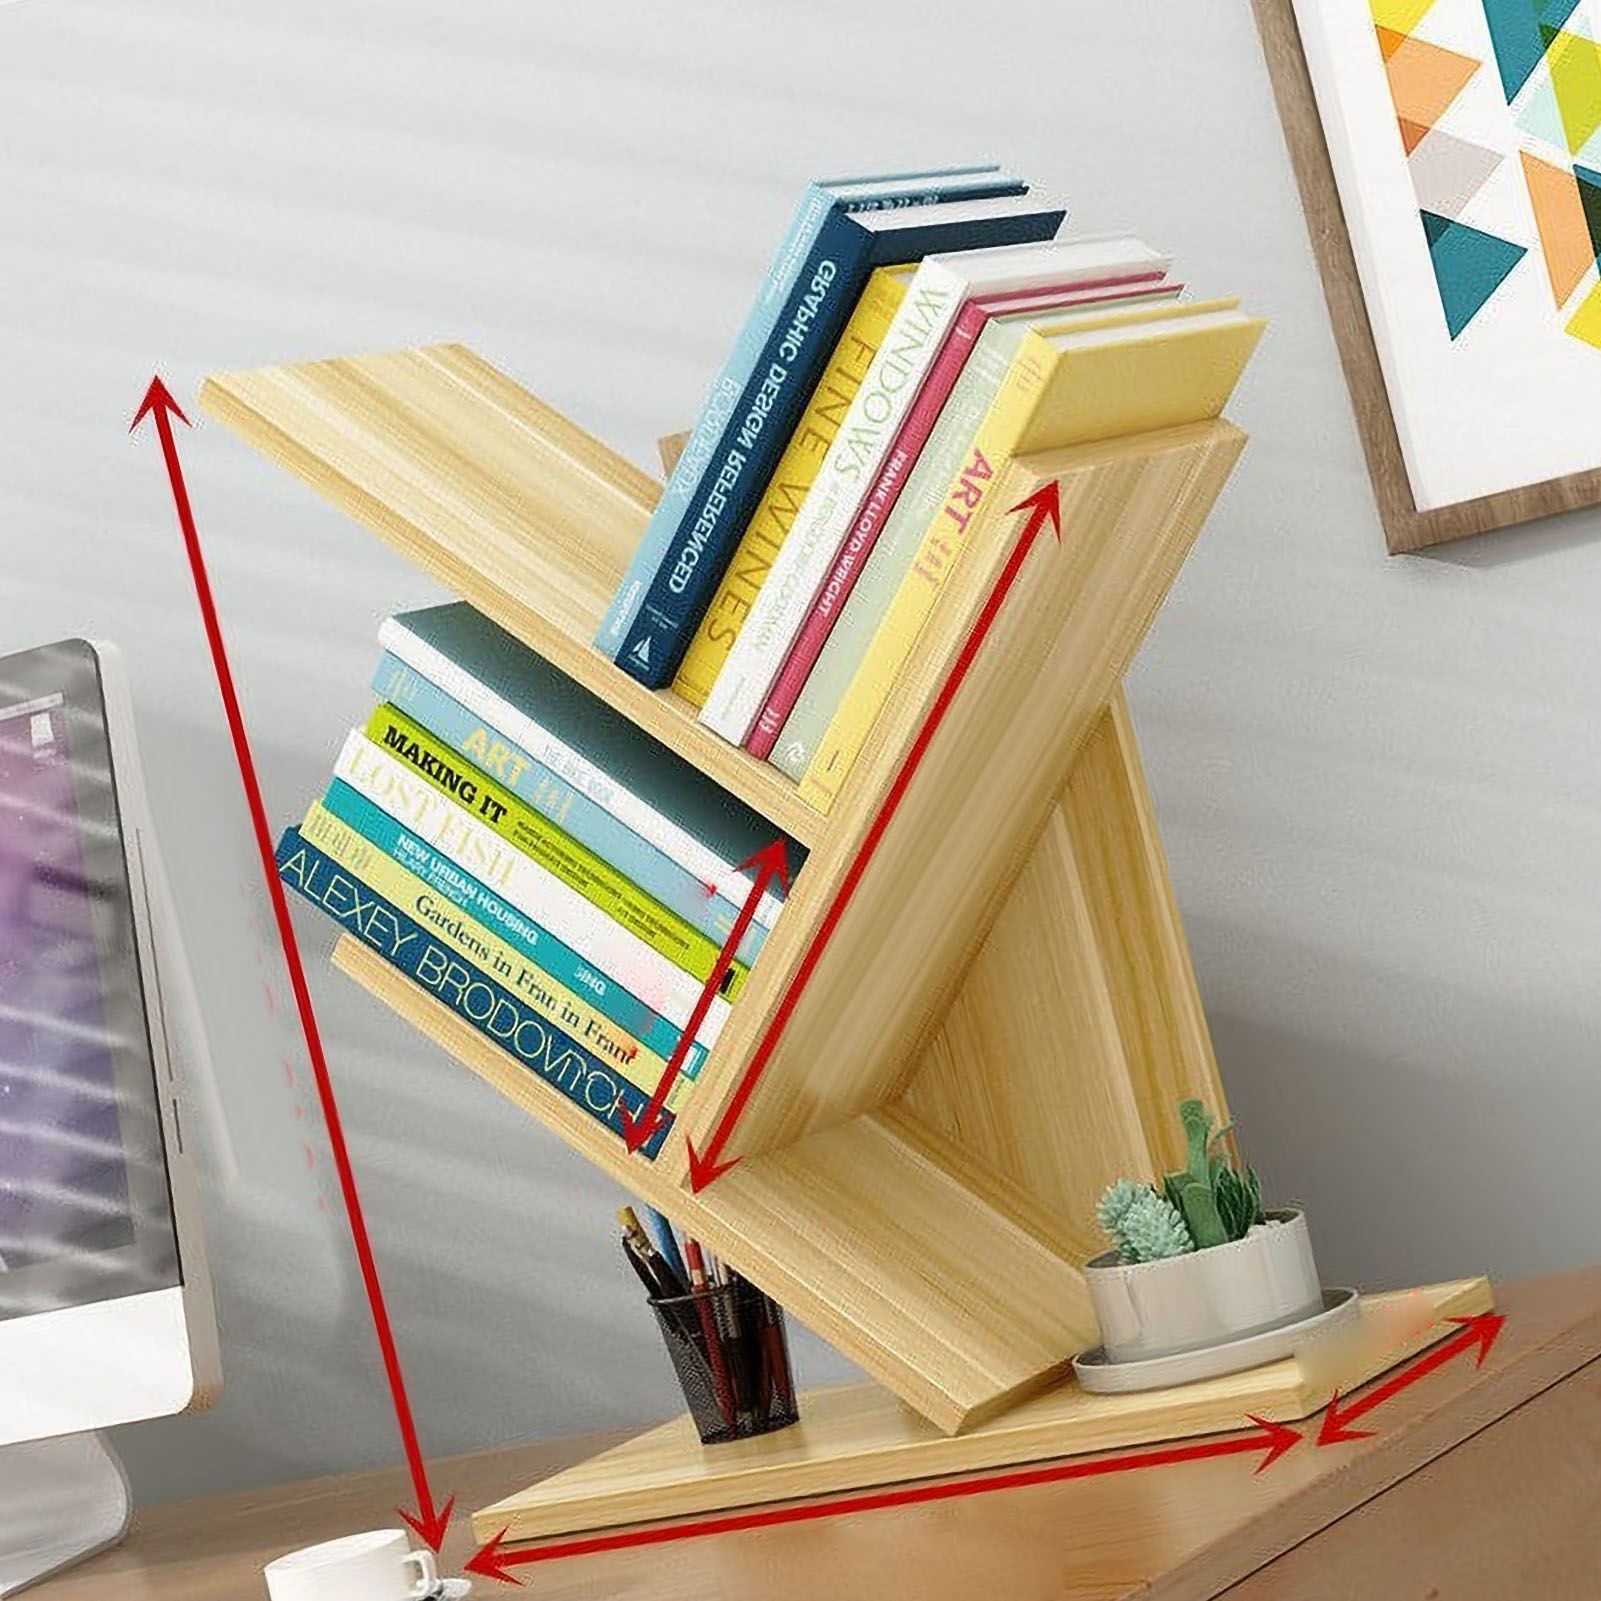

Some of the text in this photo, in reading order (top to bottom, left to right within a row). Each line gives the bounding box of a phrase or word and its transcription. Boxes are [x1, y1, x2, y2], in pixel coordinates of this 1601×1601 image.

[799, 336, 878, 460] FINE
[834, 286, 949, 480] WINDOWS
[818, 449, 908, 617] FRANK LLOYD WRIGHT
[944, 447, 994, 534] ART
[708, 482, 811, 651] WINES
[383, 725, 478, 804] MAKING
[479, 795, 508, 824] IT
[463, 726, 531, 788] ART
[278, 848, 418, 957] ALEXEY
[397, 834, 430, 863] NEW
[476, 894, 538, 946] HOUSING
[416, 895, 490, 961] Gardens
[493, 951, 512, 977] in
[561, 1001, 580, 1027] in
